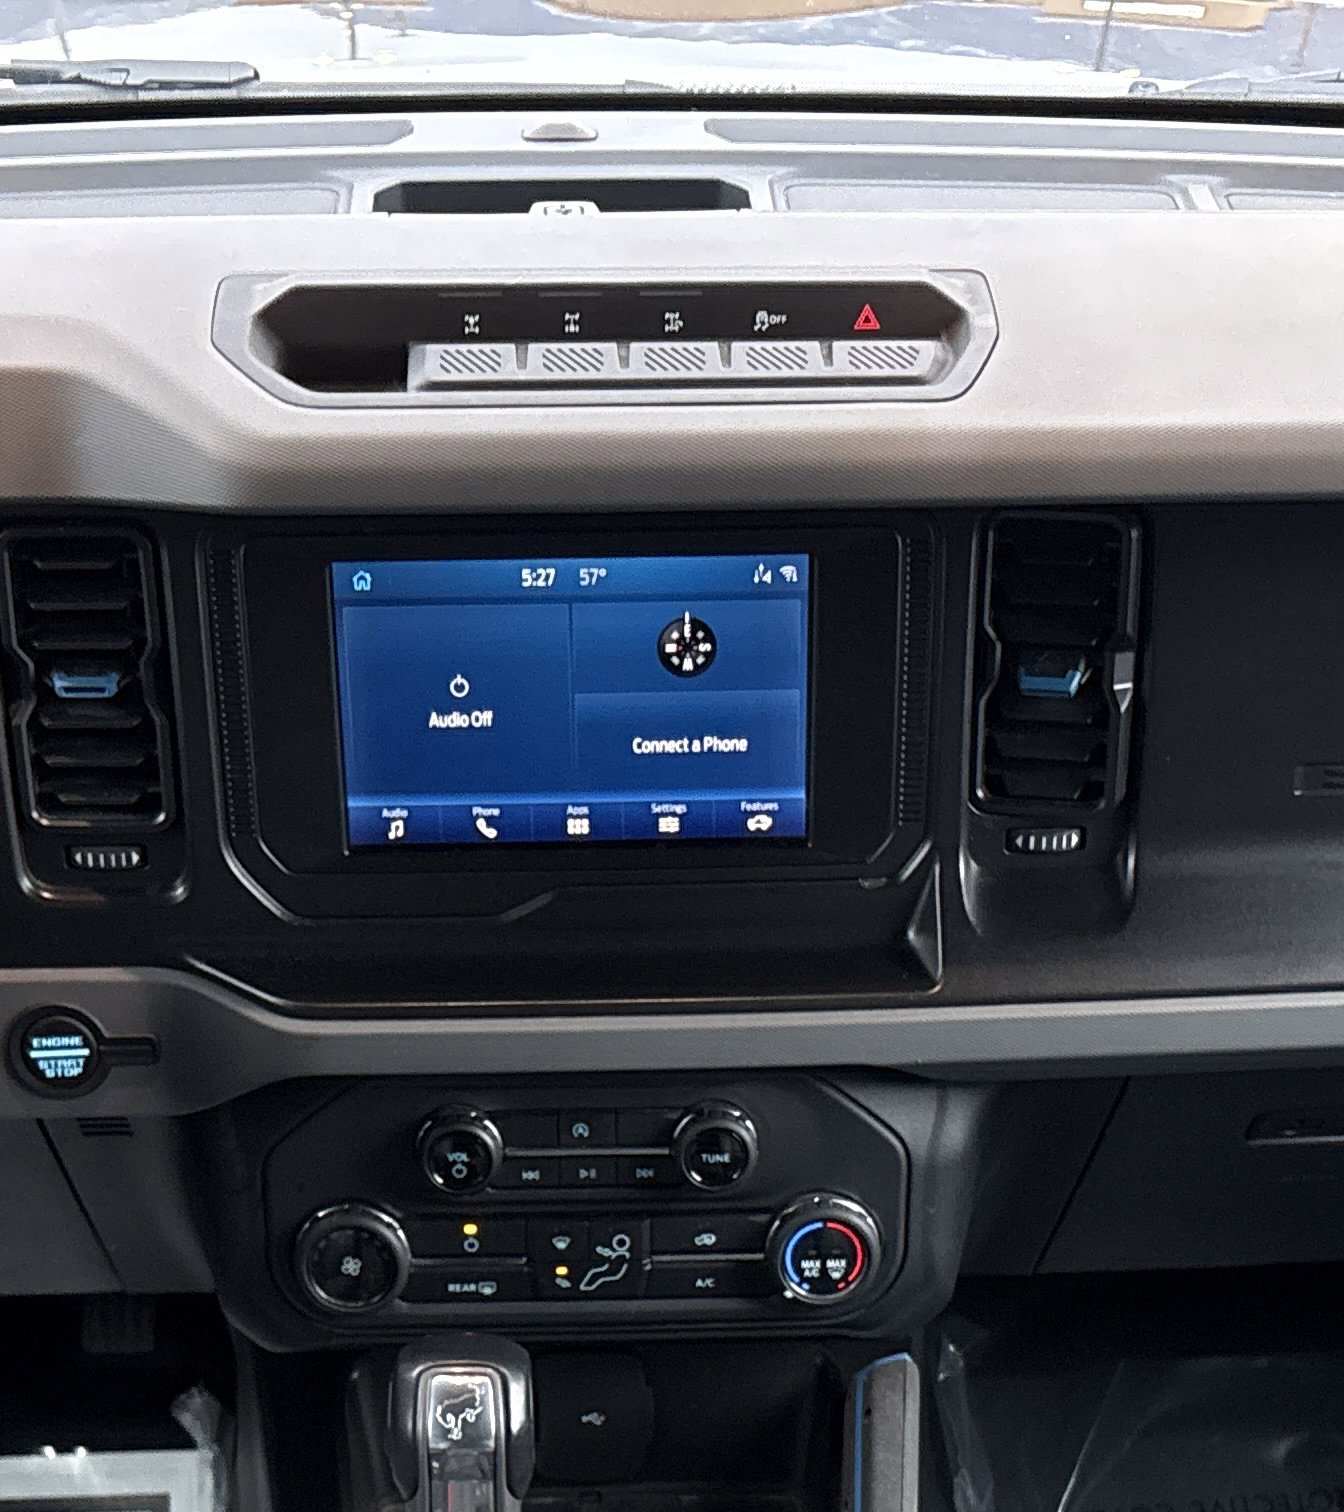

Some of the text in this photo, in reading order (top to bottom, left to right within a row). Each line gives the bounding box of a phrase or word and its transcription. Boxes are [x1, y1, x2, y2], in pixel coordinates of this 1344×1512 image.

[521, 567, 556, 587] 5:27
[429, 710, 493, 728] Audio Off
[632, 735, 749, 754] Connect a Phone
[472, 806, 500, 817] Phone
[740, 801, 780, 812] Features
[382, 807, 408, 819] Audio
[32, 1036, 84, 1048] ENGINE
[45, 1068, 83, 1078] STOP
[447, 1151, 469, 1163] VOL
[701, 1153, 731, 1164] TUNE
[800, 1260, 821, 1270] MAX
[826, 1259, 847, 1269] MAX
[447, 1283, 477, 1293] REAR
[695, 1277, 716, 1289] A/C
